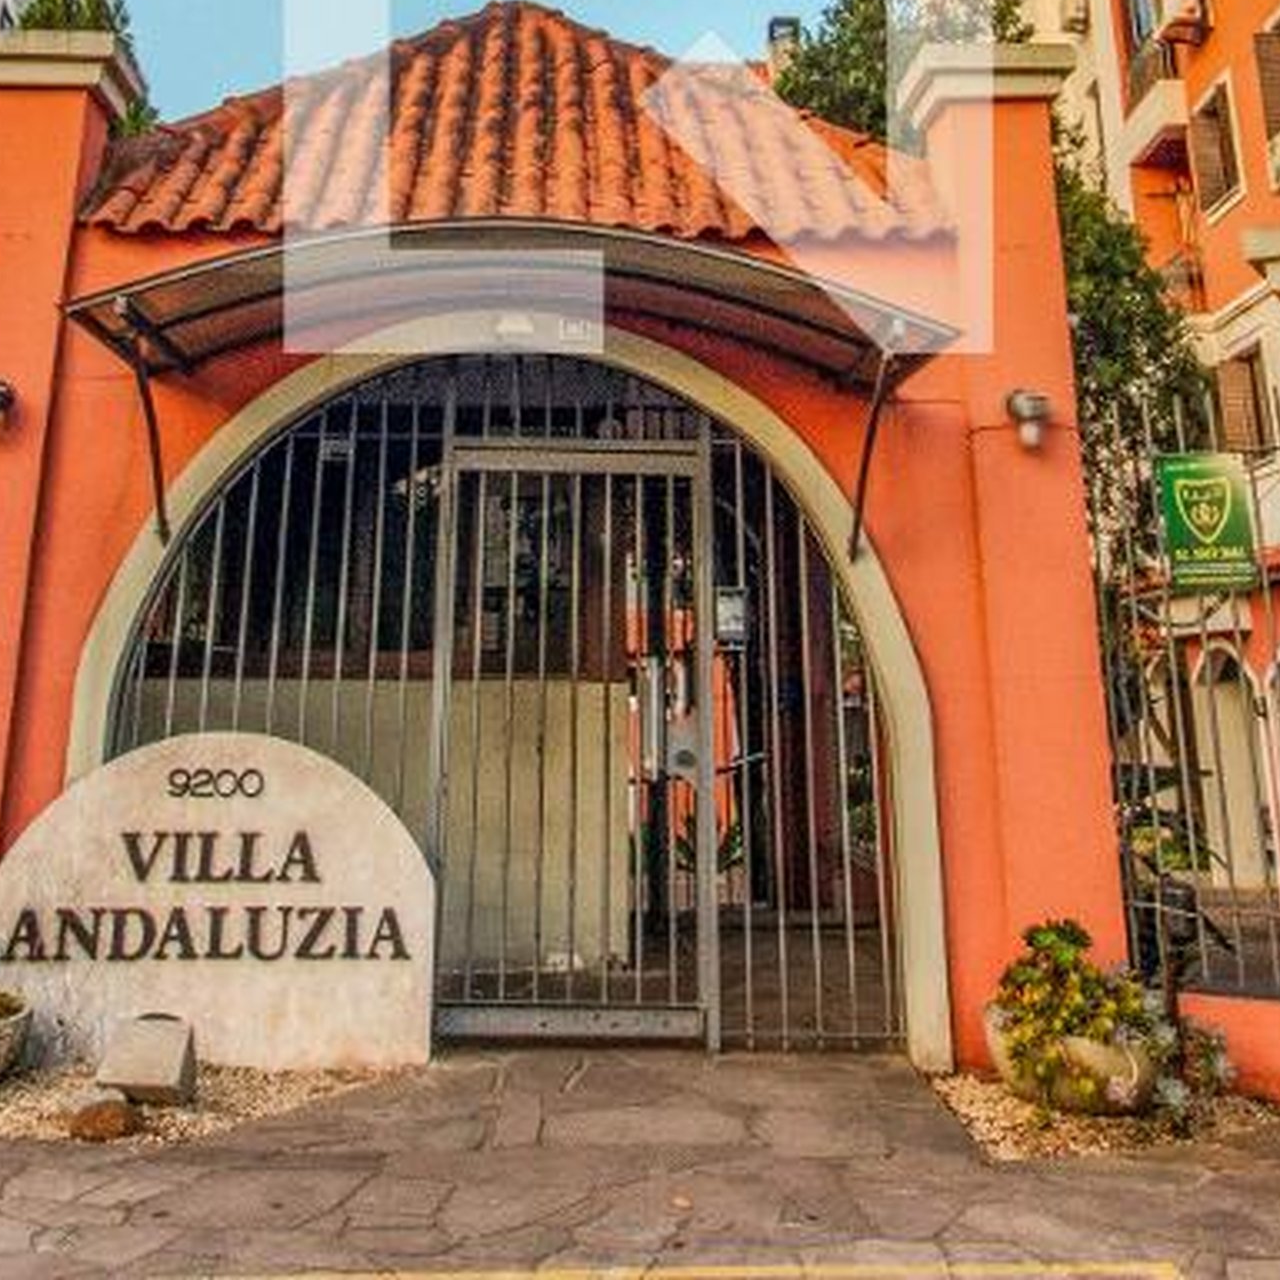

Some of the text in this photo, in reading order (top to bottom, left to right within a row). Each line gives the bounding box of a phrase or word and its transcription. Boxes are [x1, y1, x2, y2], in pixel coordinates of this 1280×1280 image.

[167, 768, 265, 798] 9200
[120, 830, 321, 884] VILLA
[0, 906, 412, 962] ANDALUZIA
